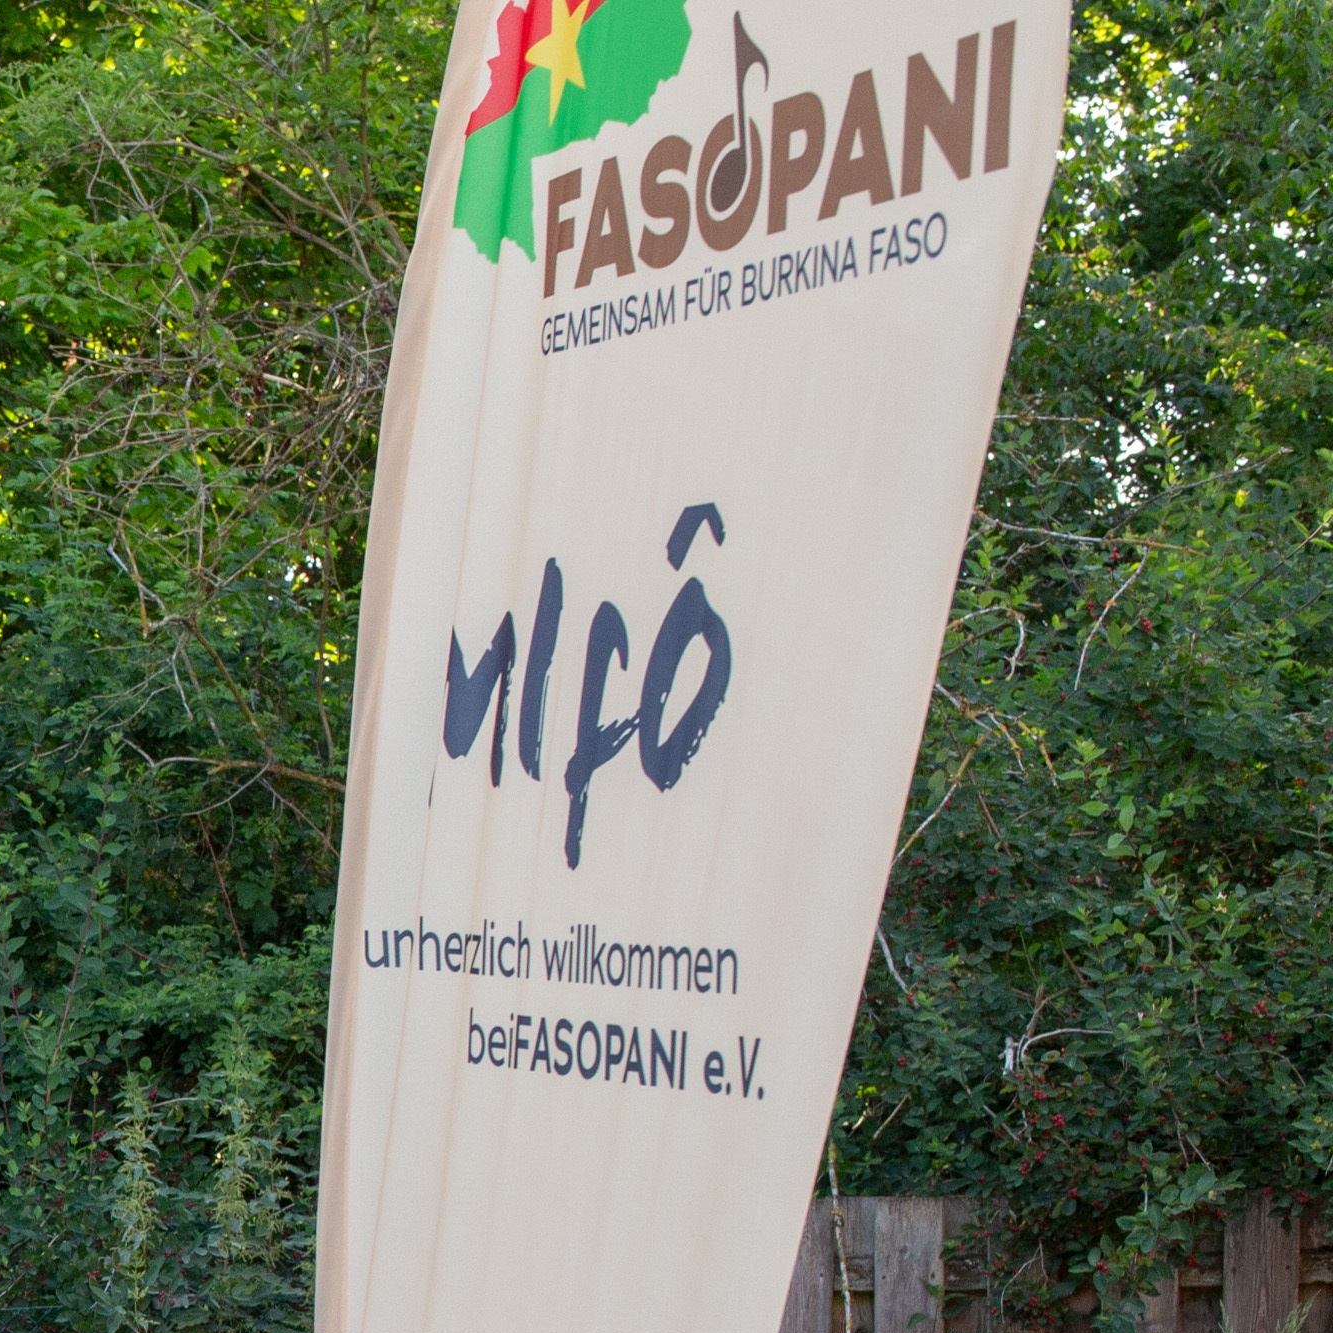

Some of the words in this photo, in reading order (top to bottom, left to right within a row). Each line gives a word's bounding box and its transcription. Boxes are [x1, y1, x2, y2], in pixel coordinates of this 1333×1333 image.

[543, 15, 1017, 299] FASOPANI
[540, 284, 676, 357] GEMEINSAM
[683, 267, 733, 321] FÜR
[740, 236, 859, 308] BURKINA
[867, 211, 949, 275] FASO
[542, 923, 739, 995] willkommen
[703, 1035, 765, 1101] e.V.
